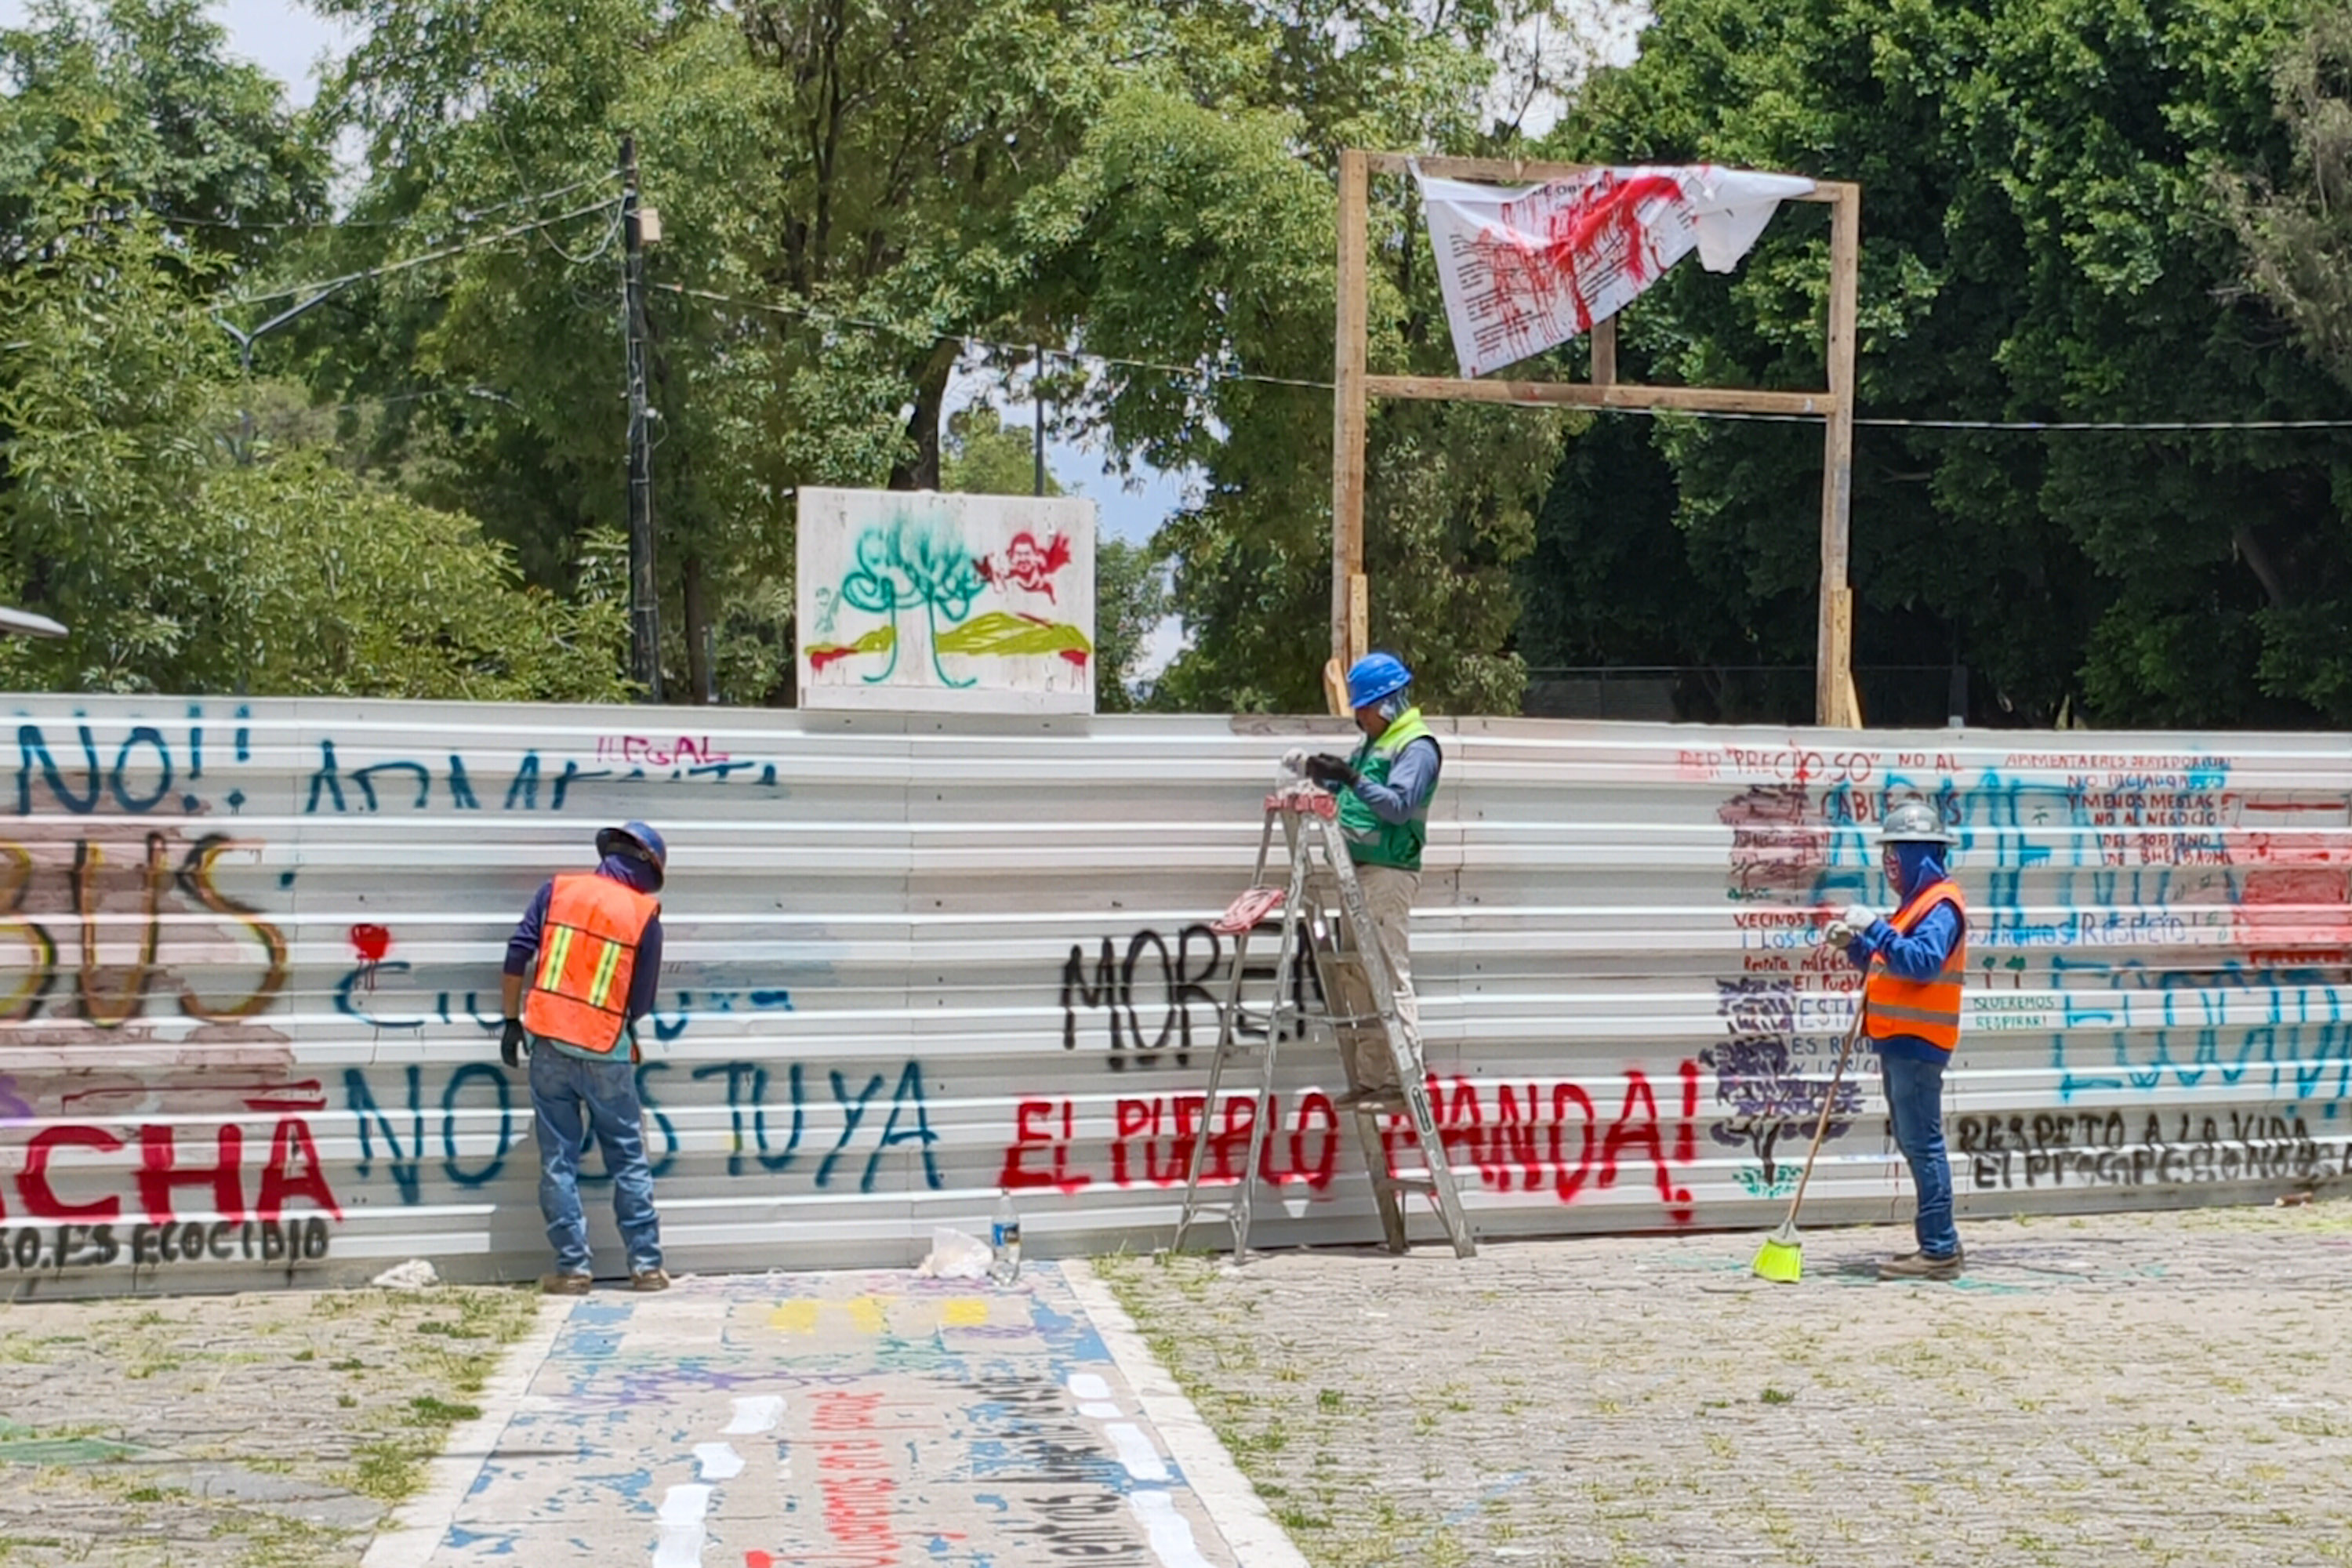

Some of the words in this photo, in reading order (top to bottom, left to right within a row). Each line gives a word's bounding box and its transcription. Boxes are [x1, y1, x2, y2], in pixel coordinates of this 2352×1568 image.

[1898, 753, 1926, 768] NO
[1935, 753, 1962, 771] AL
[2082, 794, 2146, 809] MENOS
[2093, 812, 2115, 826] NO
[1733, 913, 1806, 928] VECINOS
[1790, 1036, 1820, 1055] ES
[343, 1061, 512, 1204] NO
[692, 1060, 945, 1192] TUYA
[999, 1098, 1093, 1193] EL
[997, 1491, 1154, 1568] ientras
